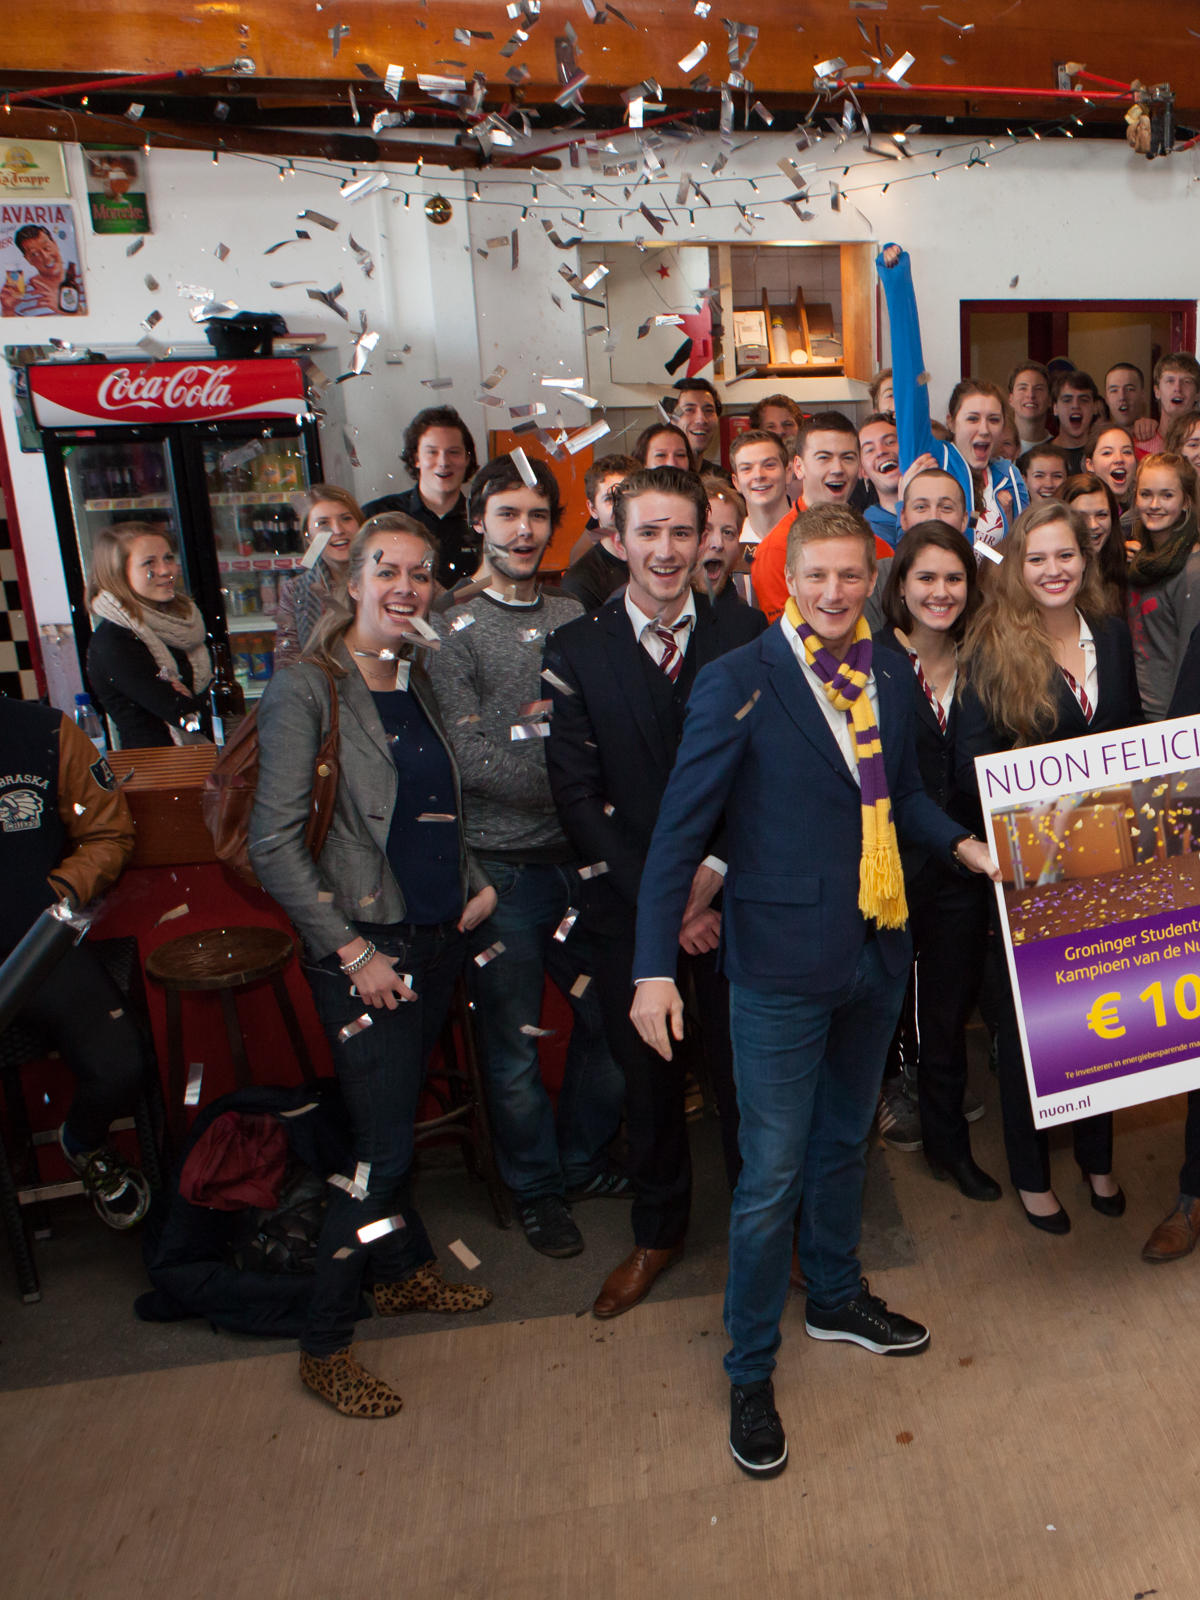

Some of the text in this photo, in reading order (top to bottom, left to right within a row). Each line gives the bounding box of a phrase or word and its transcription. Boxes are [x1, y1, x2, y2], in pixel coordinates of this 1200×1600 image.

[2, 206, 66, 224] AVARIA
[98, 365, 237, 410] Coca-Cola
[976, 530, 995, 545] GIR
[0, 774, 50, 790] BRASKA
[986, 750, 1090, 798] NUON
[1065, 935, 1137, 961] Groninger
[1055, 958, 1130, 984] Kampioen
[1133, 951, 1160, 966] van
[1163, 945, 1181, 959] de
[1086, 992, 1126, 1039] €
[1065, 1071, 1075, 1080] Te
[1076, 1062, 1113, 1077] investeren
[1122, 1043, 1188, 1065] energiebesparende
[1039, 1095, 1091, 1119] nuon.nl
